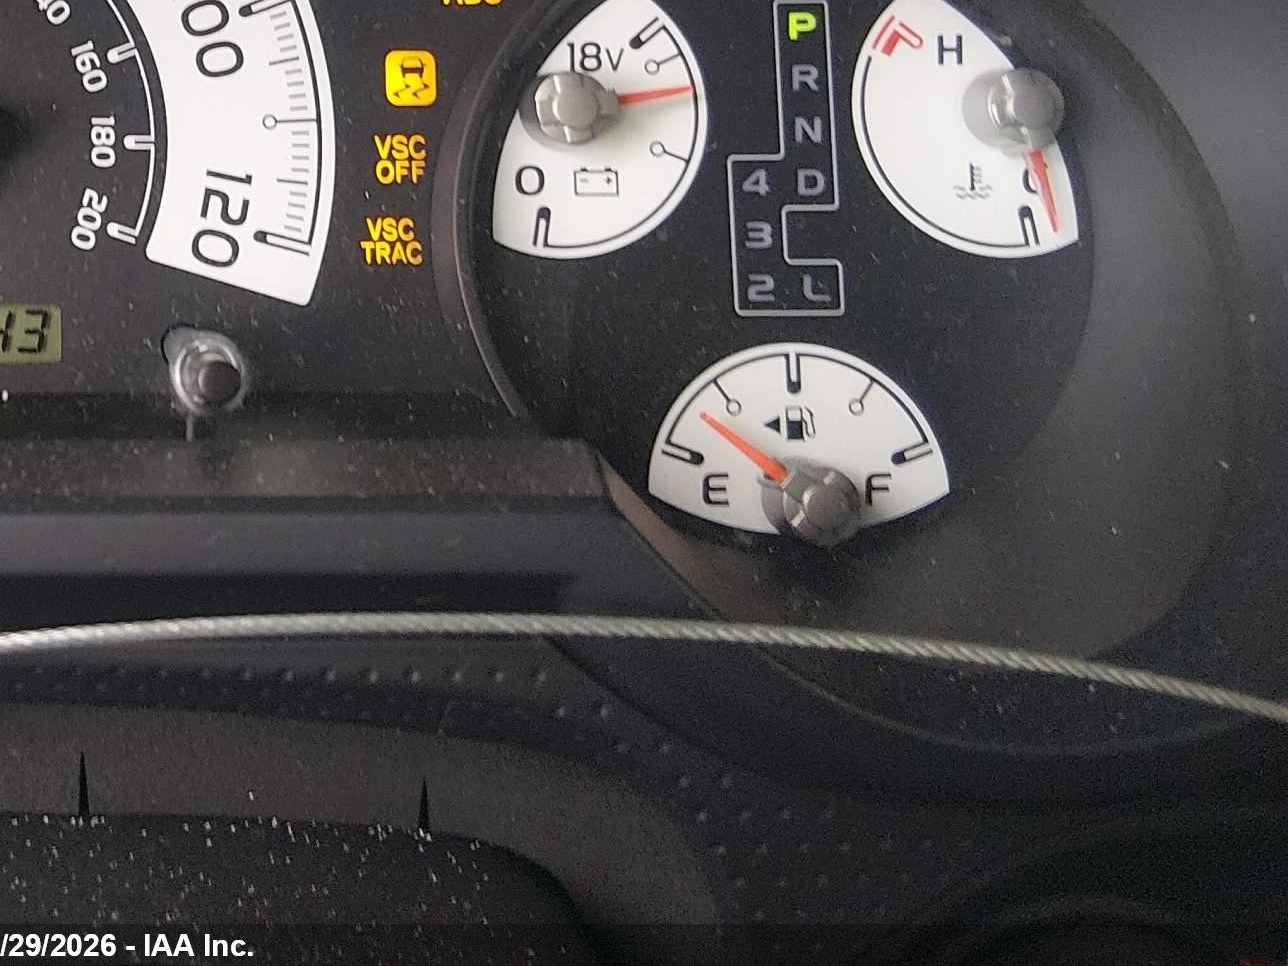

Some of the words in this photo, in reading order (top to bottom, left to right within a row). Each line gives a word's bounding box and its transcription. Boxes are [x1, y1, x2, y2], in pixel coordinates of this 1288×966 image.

[788, 12, 816, 40] P
[936, 35, 963, 65] H
[70, 41, 107, 93] 160
[792, 65, 819, 91] R
[90, 116, 115, 168] 180
[794, 117, 822, 144] N
[374, 135, 426, 160] VSC
[375, 160, 426, 184] OFF
[743, 169, 770, 196] 4
[798, 169, 825, 197] D
[71, 188, 108, 251] 200
[191, 169, 252, 267] 120
[366, 217, 415, 241] VSC
[745, 222, 772, 249] 3
[361, 241, 423, 265] TRAC
[747, 274, 775, 301] 2
[804, 274, 830, 302] L
[703, 472, 730, 506] E
[865, 472, 892, 506] F
